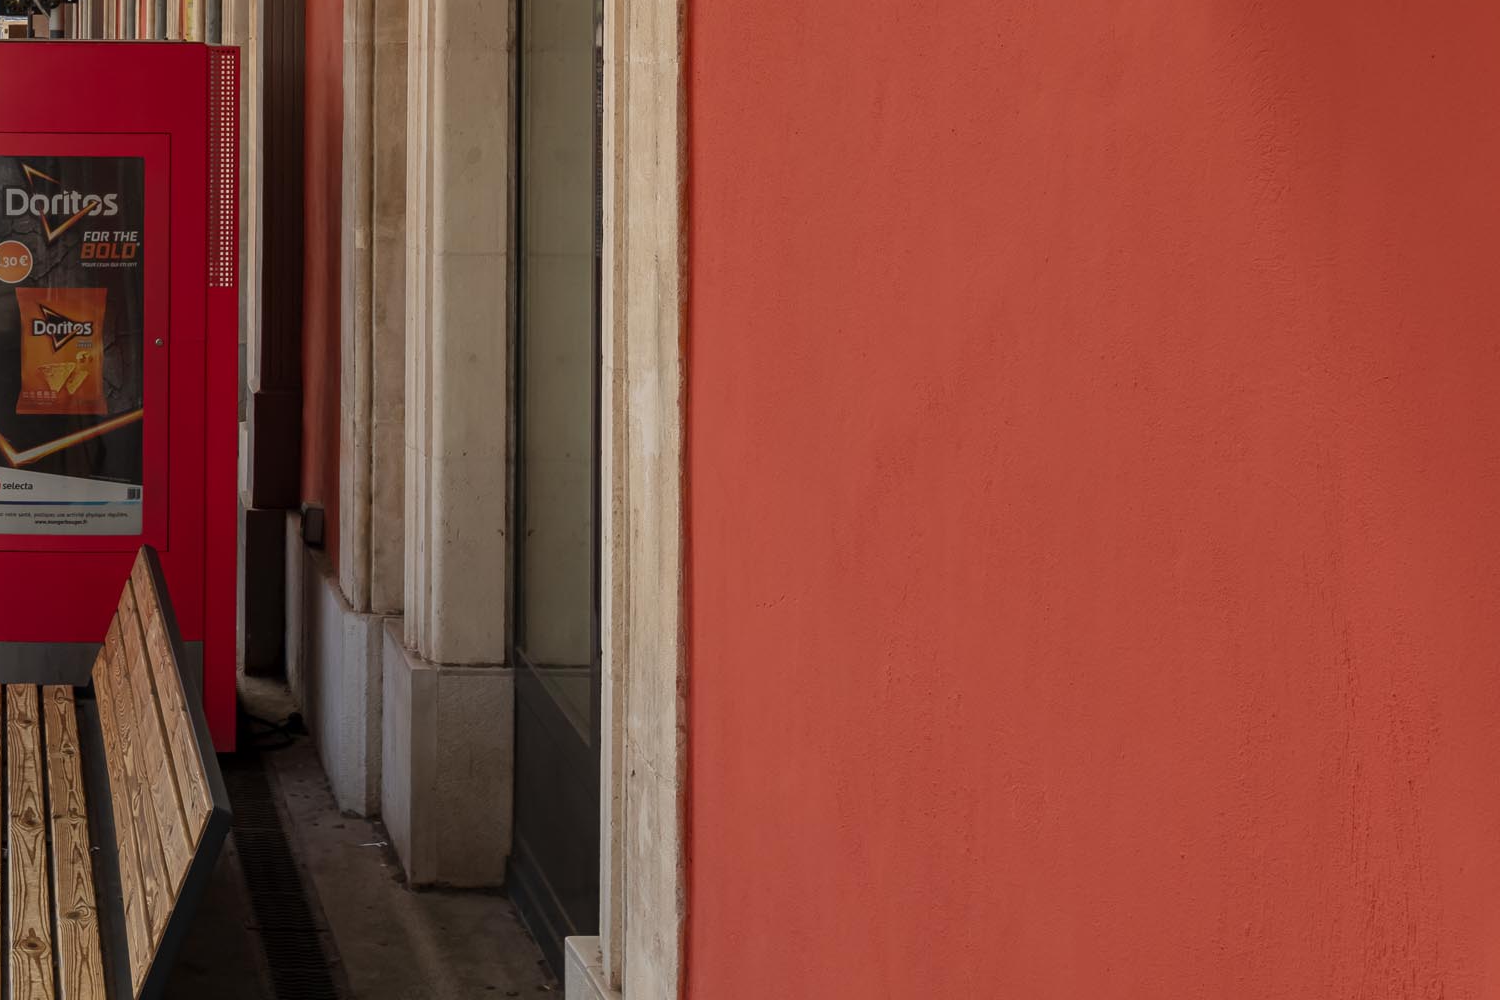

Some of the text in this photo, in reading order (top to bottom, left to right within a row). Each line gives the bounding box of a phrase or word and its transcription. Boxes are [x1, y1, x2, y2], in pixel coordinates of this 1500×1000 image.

[6, 188, 118, 216] Doritos
[84, 231, 138, 241] FOR THE
[20, 255, 29, 266] €
[34, 320, 92, 335] Doritos
[2, 481, 33, 490] selecta
